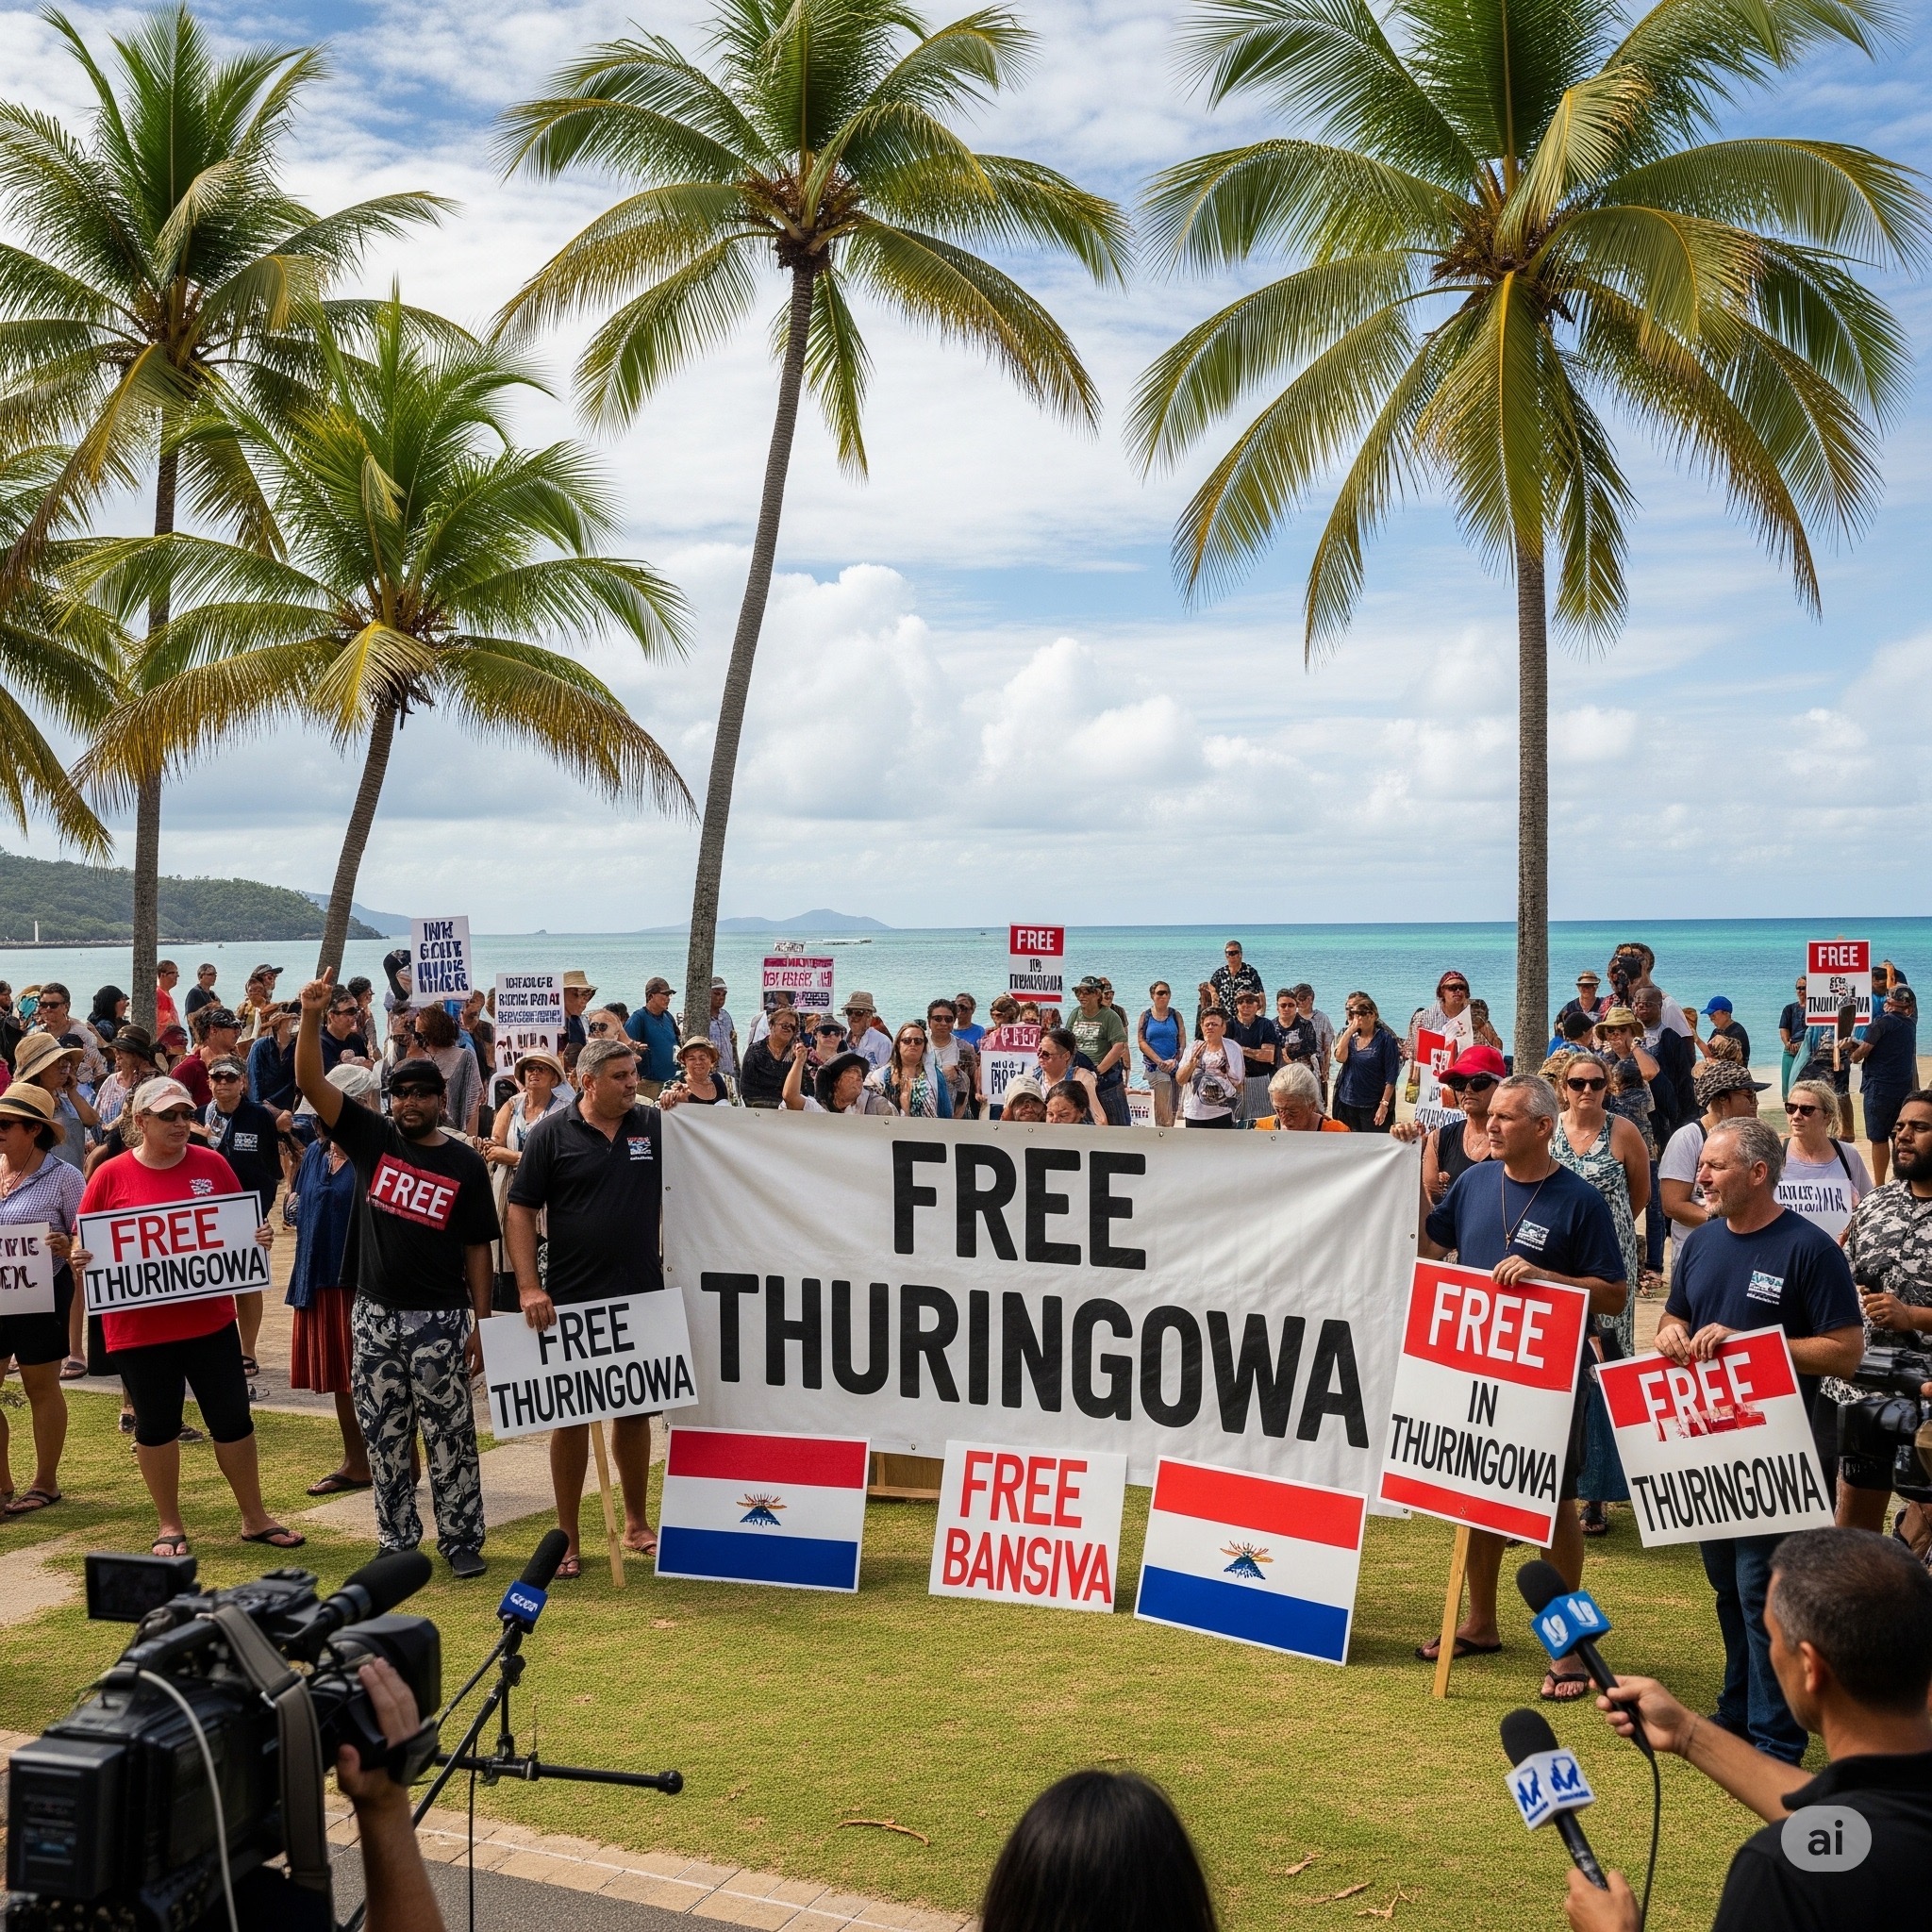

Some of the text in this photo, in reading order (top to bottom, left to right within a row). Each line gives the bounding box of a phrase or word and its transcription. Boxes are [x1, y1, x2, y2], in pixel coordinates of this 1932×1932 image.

[1017, 930, 1055, 951] FREE
[1818, 945, 1859, 967] FREE
[375, 1166, 458, 1220] FREE
[892, 1140, 1146, 1270] FREE
[110, 1207, 225, 1262] FREE
[89, 1246, 266, 1304] THURINGOWA
[538, 1303, 635, 1366] FREE
[701, 1272, 1370, 1449] THURINGOWA
[1428, 1281, 1554, 1369] FREE
[491, 1354, 695, 1428] THURINGOWA
[1468, 1380, 1497, 1427] IN
[959, 1450, 1088, 1528] FREE
[1391, 1413, 1557, 1503] THURINGOWA
[1631, 1452, 1826, 1532] THURINGOWA
[942, 1527, 1112, 1604] BANSIVA
